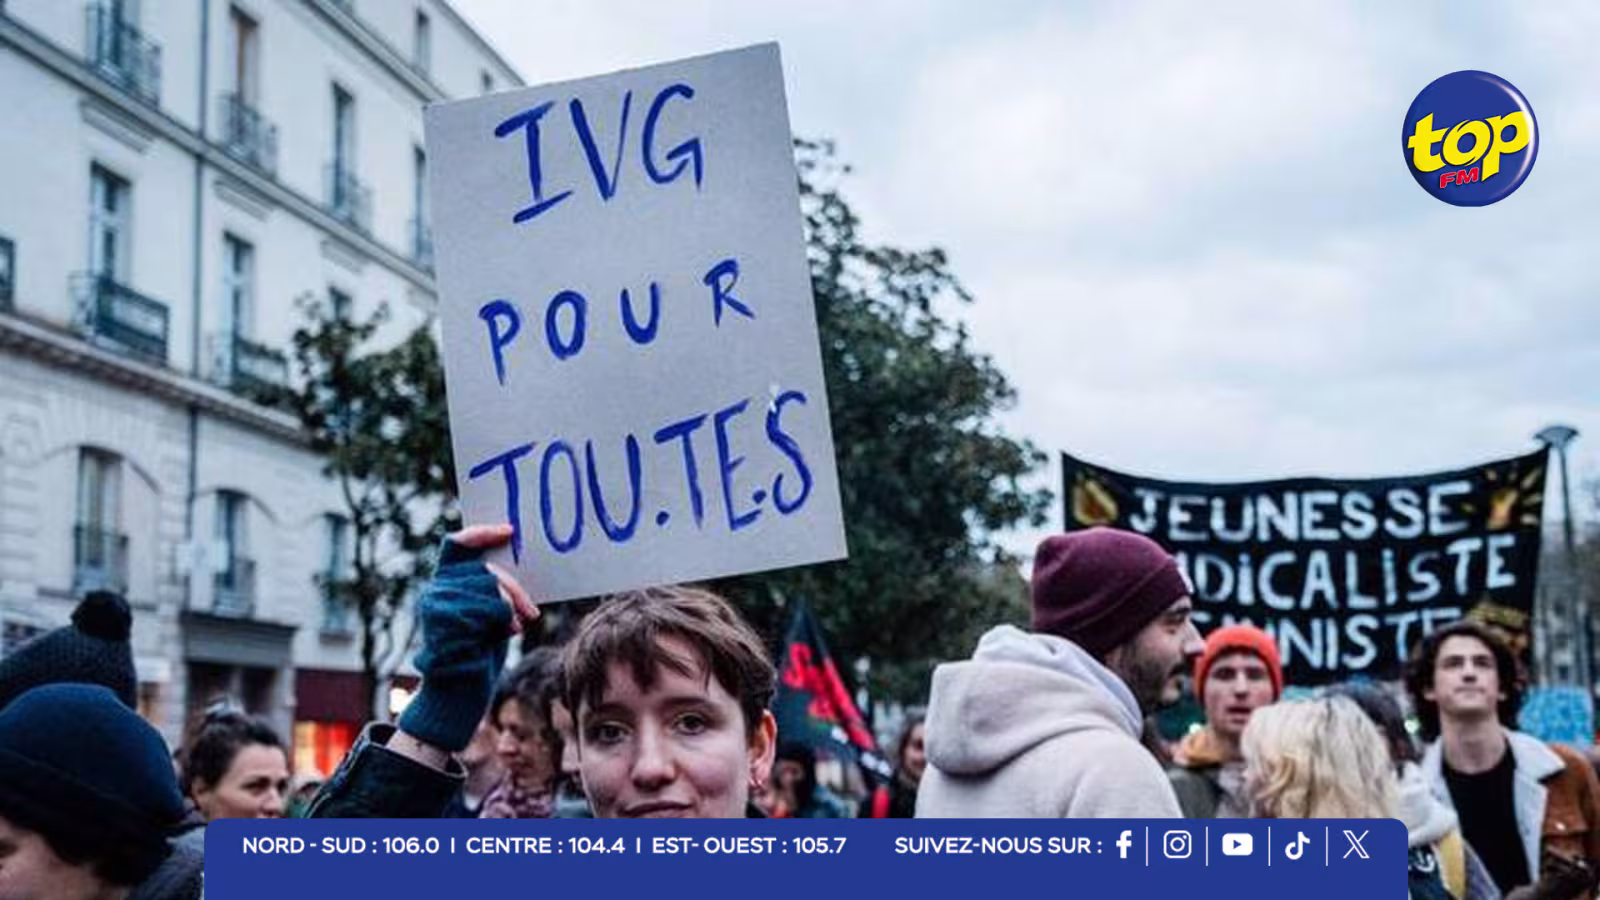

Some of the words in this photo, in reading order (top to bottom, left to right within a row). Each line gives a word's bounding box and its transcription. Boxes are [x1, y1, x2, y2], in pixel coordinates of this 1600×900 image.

[493, 83, 704, 224] IVG
[478, 258, 755, 385] POUR
[1129, 479, 1474, 541] JEUNESSE
